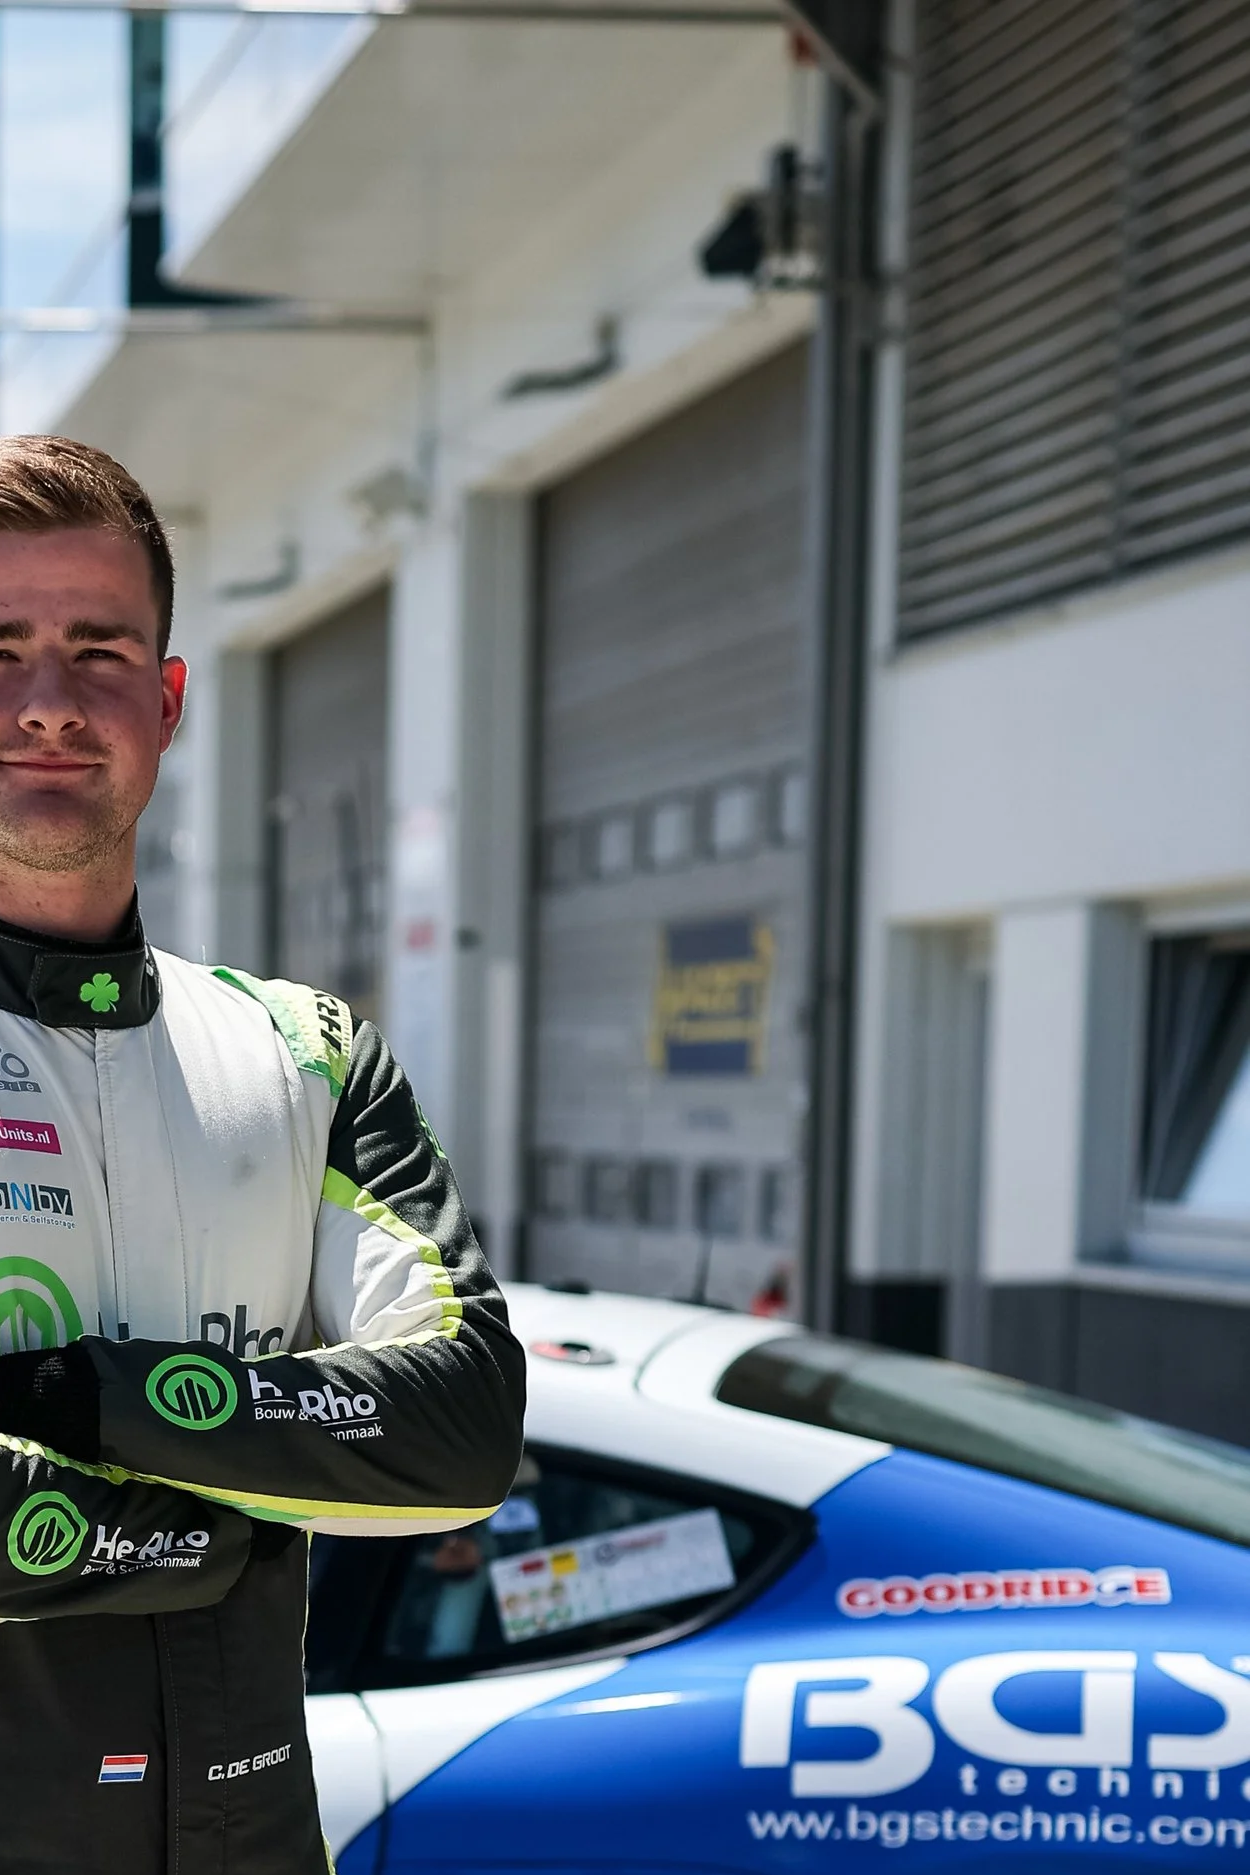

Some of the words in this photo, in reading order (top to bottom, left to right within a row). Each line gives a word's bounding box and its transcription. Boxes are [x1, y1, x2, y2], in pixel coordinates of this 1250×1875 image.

[22, 1214, 29, 1224] &
[254, 1407, 296, 1421] Bouw
[252, 1743, 292, 1772] GROOT
[959, 1761, 1250, 1801] techni
